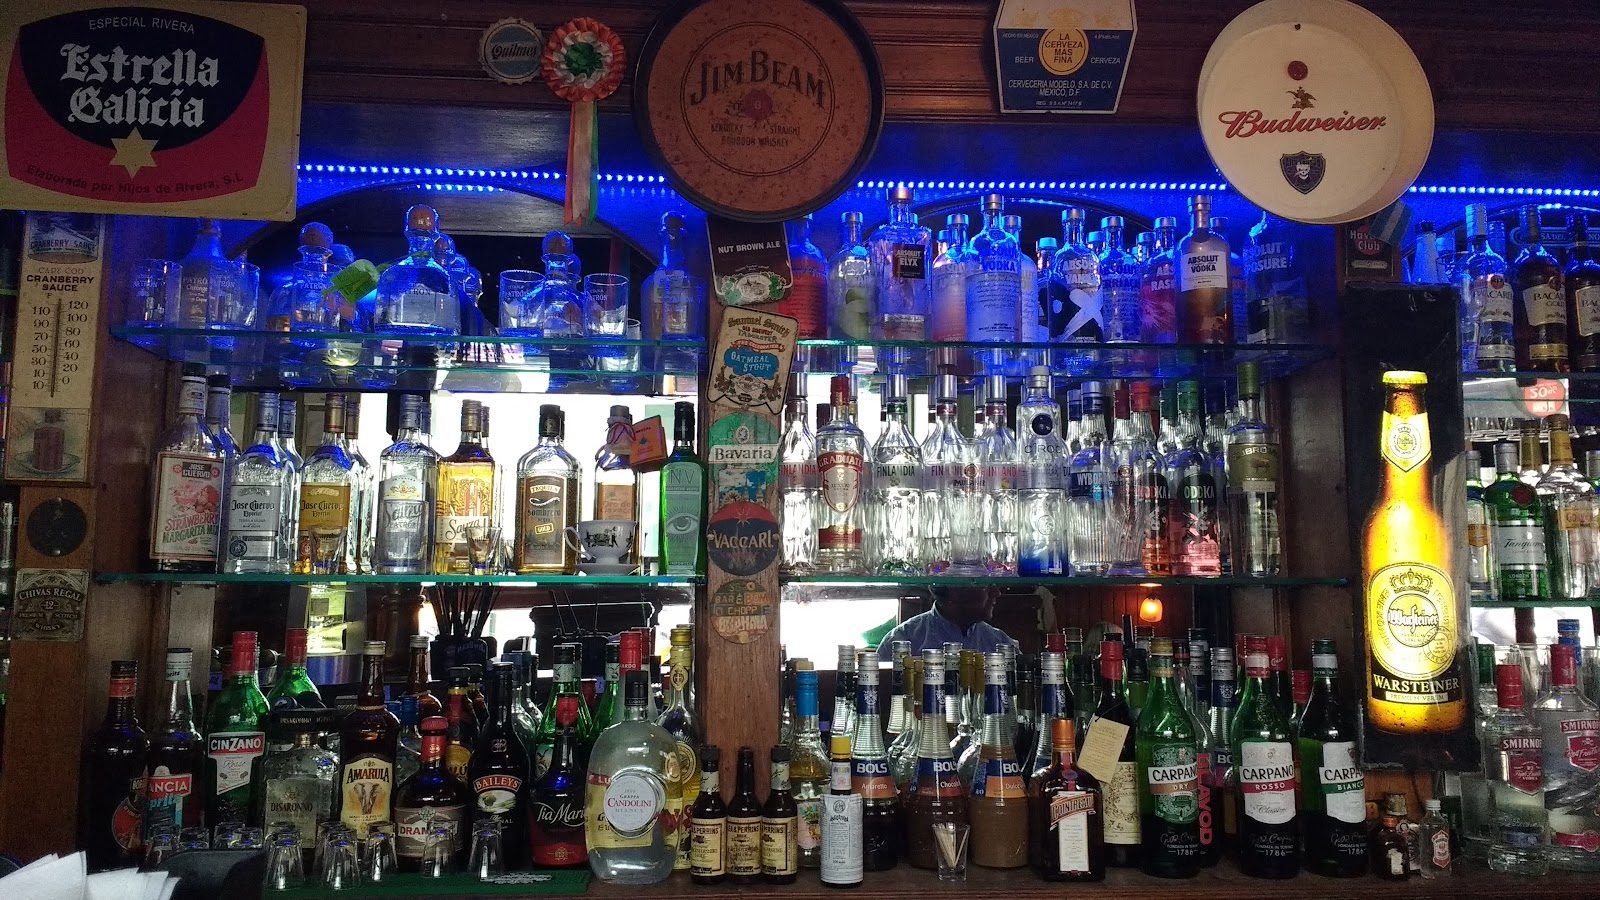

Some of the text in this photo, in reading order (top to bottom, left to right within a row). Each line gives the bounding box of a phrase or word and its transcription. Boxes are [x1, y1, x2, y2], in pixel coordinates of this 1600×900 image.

[89, 16, 195, 34] ESPECIAL RIVERA
[1059, 33, 1070, 41] LA
[492, 43, 537, 59] Quilmes
[1054, 48, 1074, 56] MAS
[60, 43, 219, 87] Estrella
[1014, 56, 1034, 64] BEER
[1053, 56, 1074, 64] FINA
[1091, 57, 1121, 65] CERVEZA
[690, 50, 825, 109] JIM BEAM
[1008, 79, 1047, 89] CERVECERIA
[1091, 80, 1101, 89] DE
[1040, 88, 1067, 98] MEXICO,
[68, 86, 205, 127] Galicia
[1218, 109, 1387, 139] Budweiser
[92, 182, 112, 194] por
[156, 183, 171, 193] de
[717, 240, 781, 254] NUT BROWN ALE
[1357, 240, 1381, 254] Club
[899, 256, 918, 267] ELYX
[1188, 254, 1219, 265] ABSOLUT
[1190, 264, 1217, 274] VODKA
[26, 274, 95, 284] CRANBERRY
[42, 284, 79, 292] SAUCE
[69, 300, 88, 310] 120
[32, 306, 51, 316] 110
[67, 312, 88, 322] 100
[34, 319, 49, 327] 90
[727, 316, 761, 329] Samuel
[66, 326, 81, 335] 80
[34, 332, 49, 340] 70
[64, 339, 80, 347] 60
[32, 345, 48, 354] 50
[64, 351, 79, 360] 40
[730, 351, 769, 364] OATMEAL
[31, 357, 47, 366] 30
[63, 364, 78, 372] 20
[742, 362, 773, 372] STOUT
[33, 369, 45, 378] 10
[62, 376, 70, 384] 0
[33, 382, 45, 390] 10
[714, 447, 772, 462] Bavaria
[182, 468, 211, 479] CUERVO
[231, 499, 275, 511] Jose Cuervo
[300, 499, 344, 511] Jose Cuervo
[527, 509, 560, 518] Sombrero
[161, 525, 205, 544] MARGARITA
[445, 518, 481, 542] Sauza
[713, 530, 772, 549] VACCARI
[18, 587, 82, 602] CHIVAS REGAL
[715, 594, 735, 604] BAR
[45, 600, 54, 610] 12
[1373, 674, 1460, 693] WARSTEINER
[1390, 693, 1420, 702] PREMIUM
[210, 737, 262, 752] CINZANO
[857, 763, 888, 774] BOLS
[1243, 764, 1295, 781] CARPANO
[346, 767, 390, 785] AMARULA
[476, 775, 519, 789] BAILEYS
[861, 782, 888, 792] Amaretto
[1173, 782, 1190, 791] DRY
[1255, 782, 1286, 792] ROSSO
[1337, 780, 1364, 791] BIANCO
[270, 802, 313, 813] DISARONNO
[607, 797, 652, 808] CANDOLINI
[536, 802, 556, 822] Tia
[1052, 795, 1095, 821] COINTREAU
[1176, 848, 1194, 856] 1786
[1265, 848, 1285, 856] 1786
